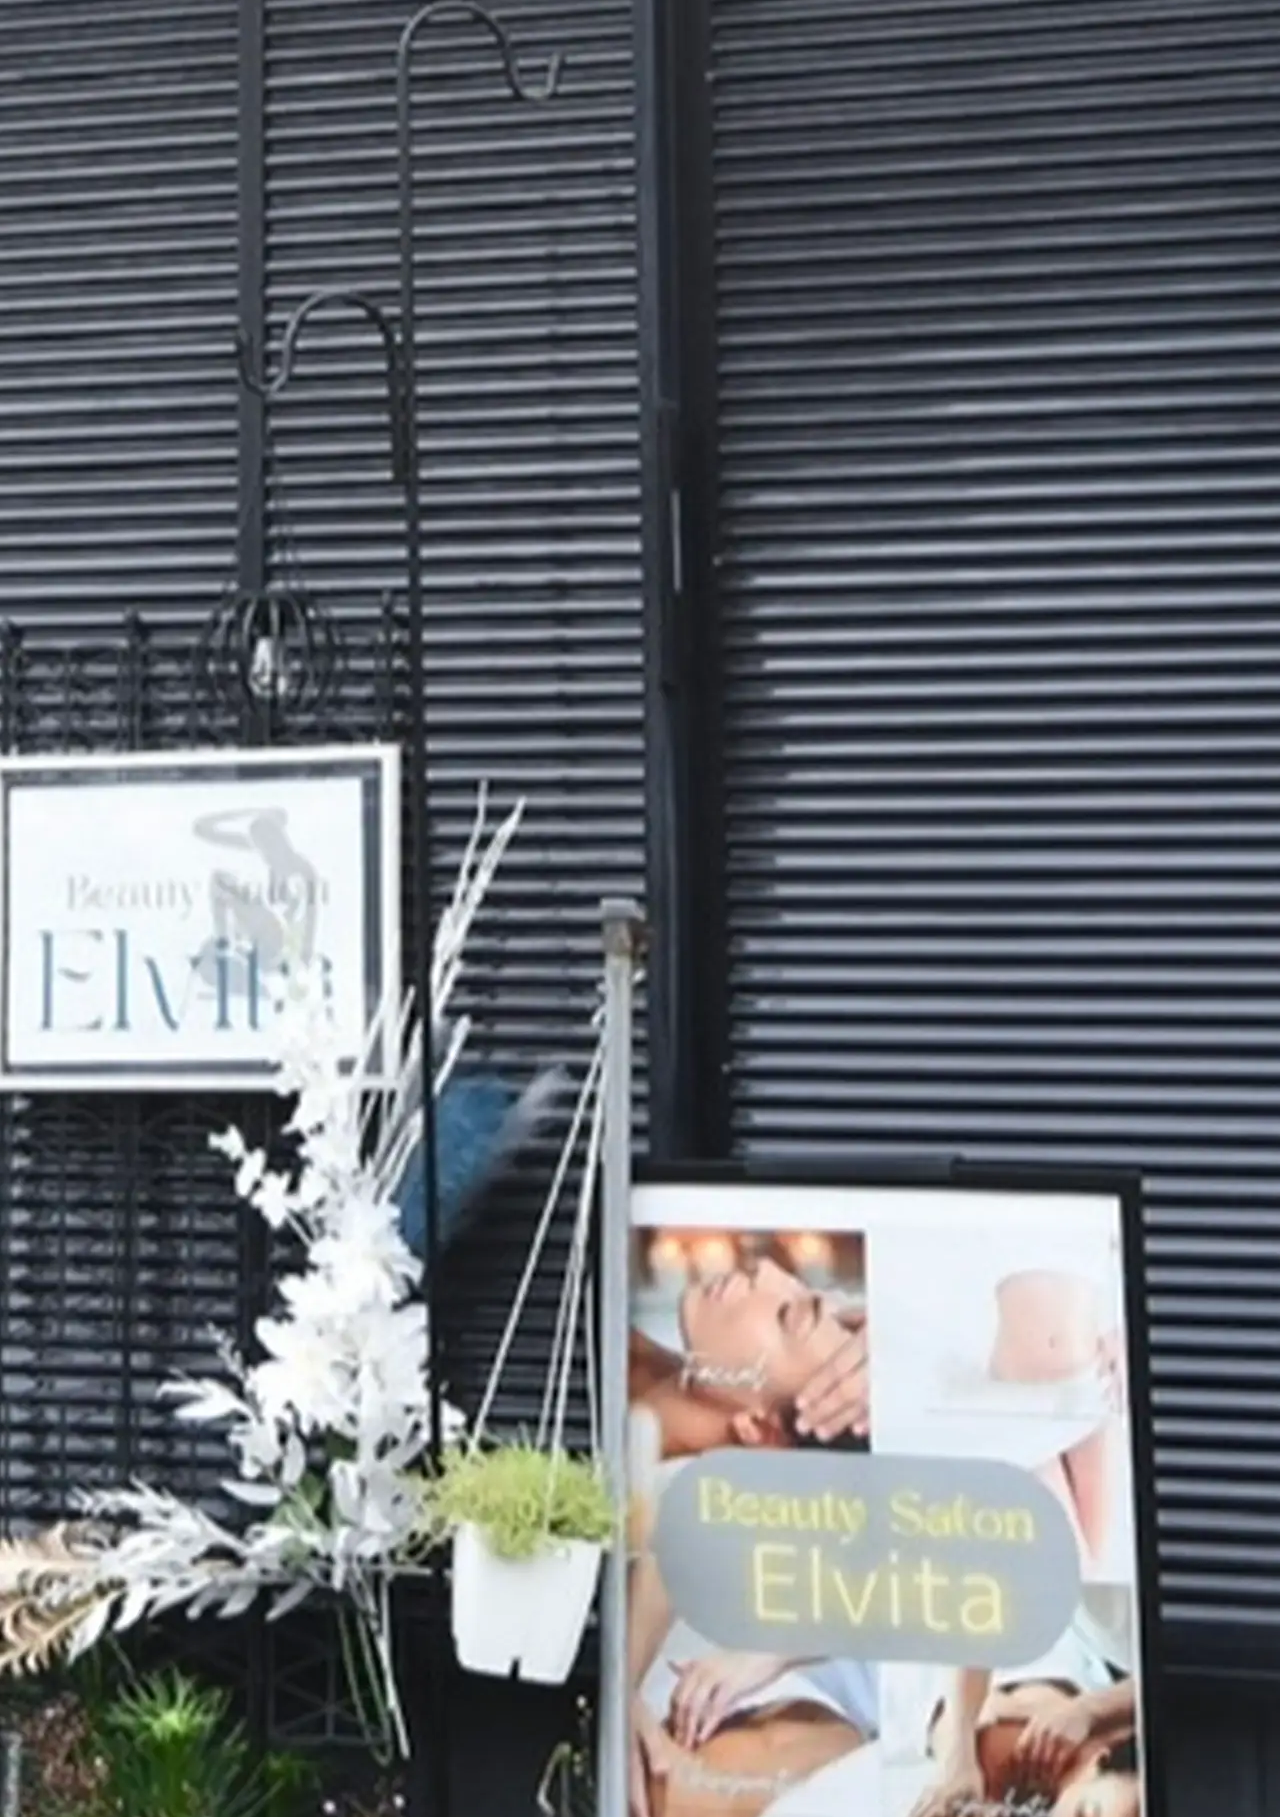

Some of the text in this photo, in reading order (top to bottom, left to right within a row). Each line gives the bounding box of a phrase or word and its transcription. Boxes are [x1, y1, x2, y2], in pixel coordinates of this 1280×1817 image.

[66, 874, 202, 920] Beauty
[697, 1475, 1036, 1545] Beauty Salon
[752, 1541, 1004, 1636] Elvita
